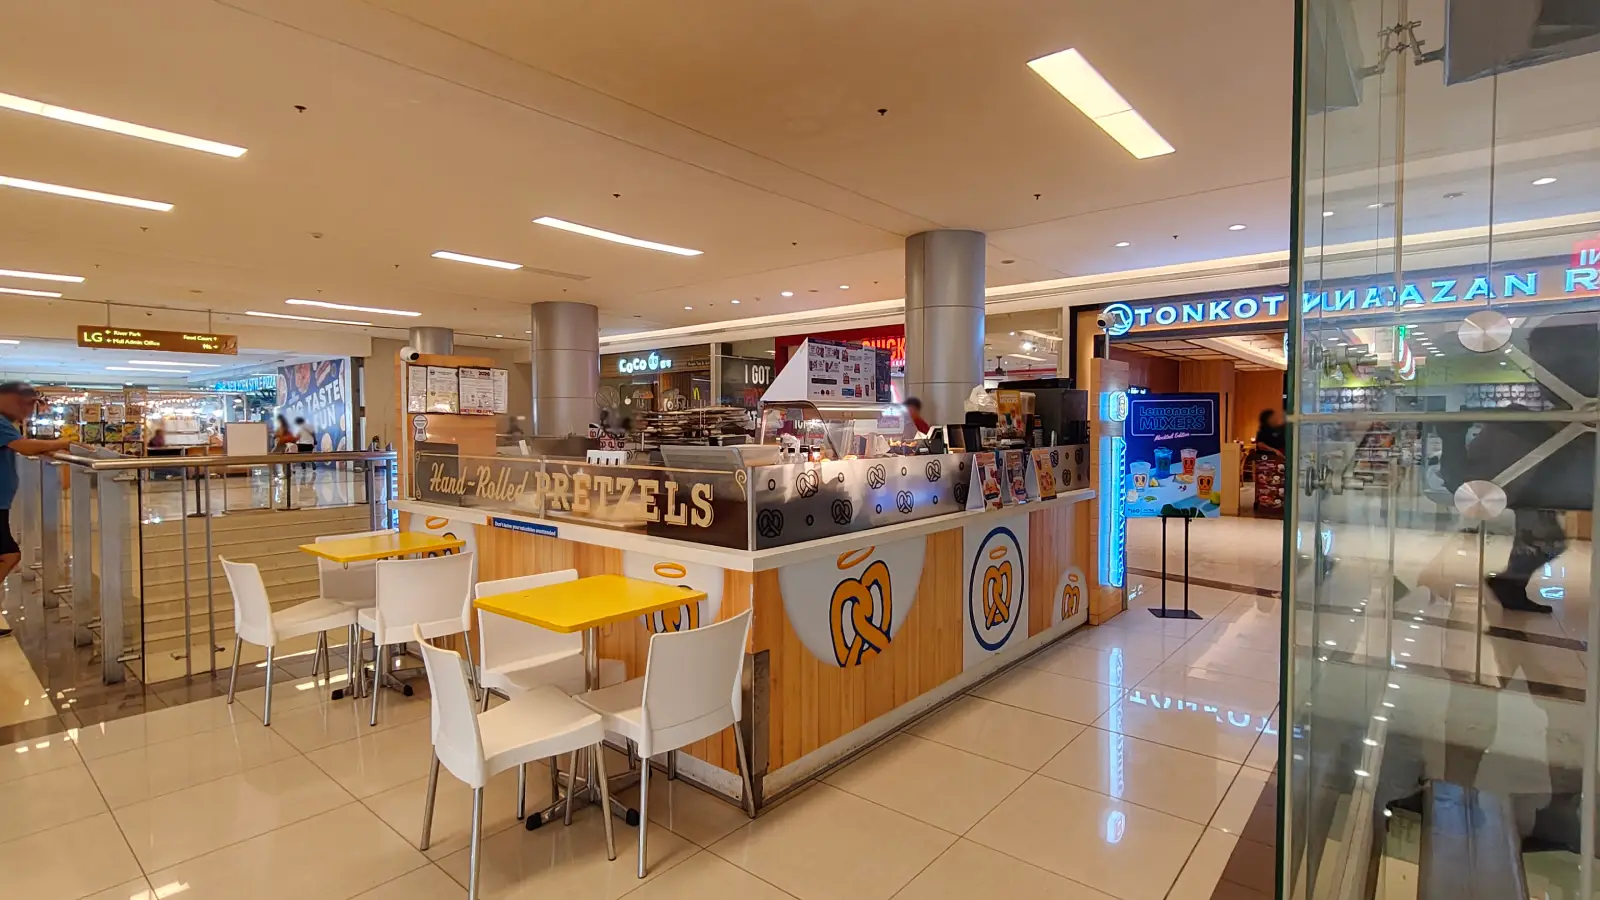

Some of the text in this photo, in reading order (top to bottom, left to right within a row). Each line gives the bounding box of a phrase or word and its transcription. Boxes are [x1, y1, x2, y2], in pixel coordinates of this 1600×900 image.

[84, 331, 103, 343] LG
[125, 338, 143, 346] Admin
[744, 363, 771, 385] I GOT
[305, 379, 341, 413] TASTE
[1140, 404, 1205, 417] Lemonade
[1140, 416, 1205, 431] MIXERS
[429, 462, 714, 529] Hand-Rolled PRETZELS
[535, 528, 556, 536] unattended
